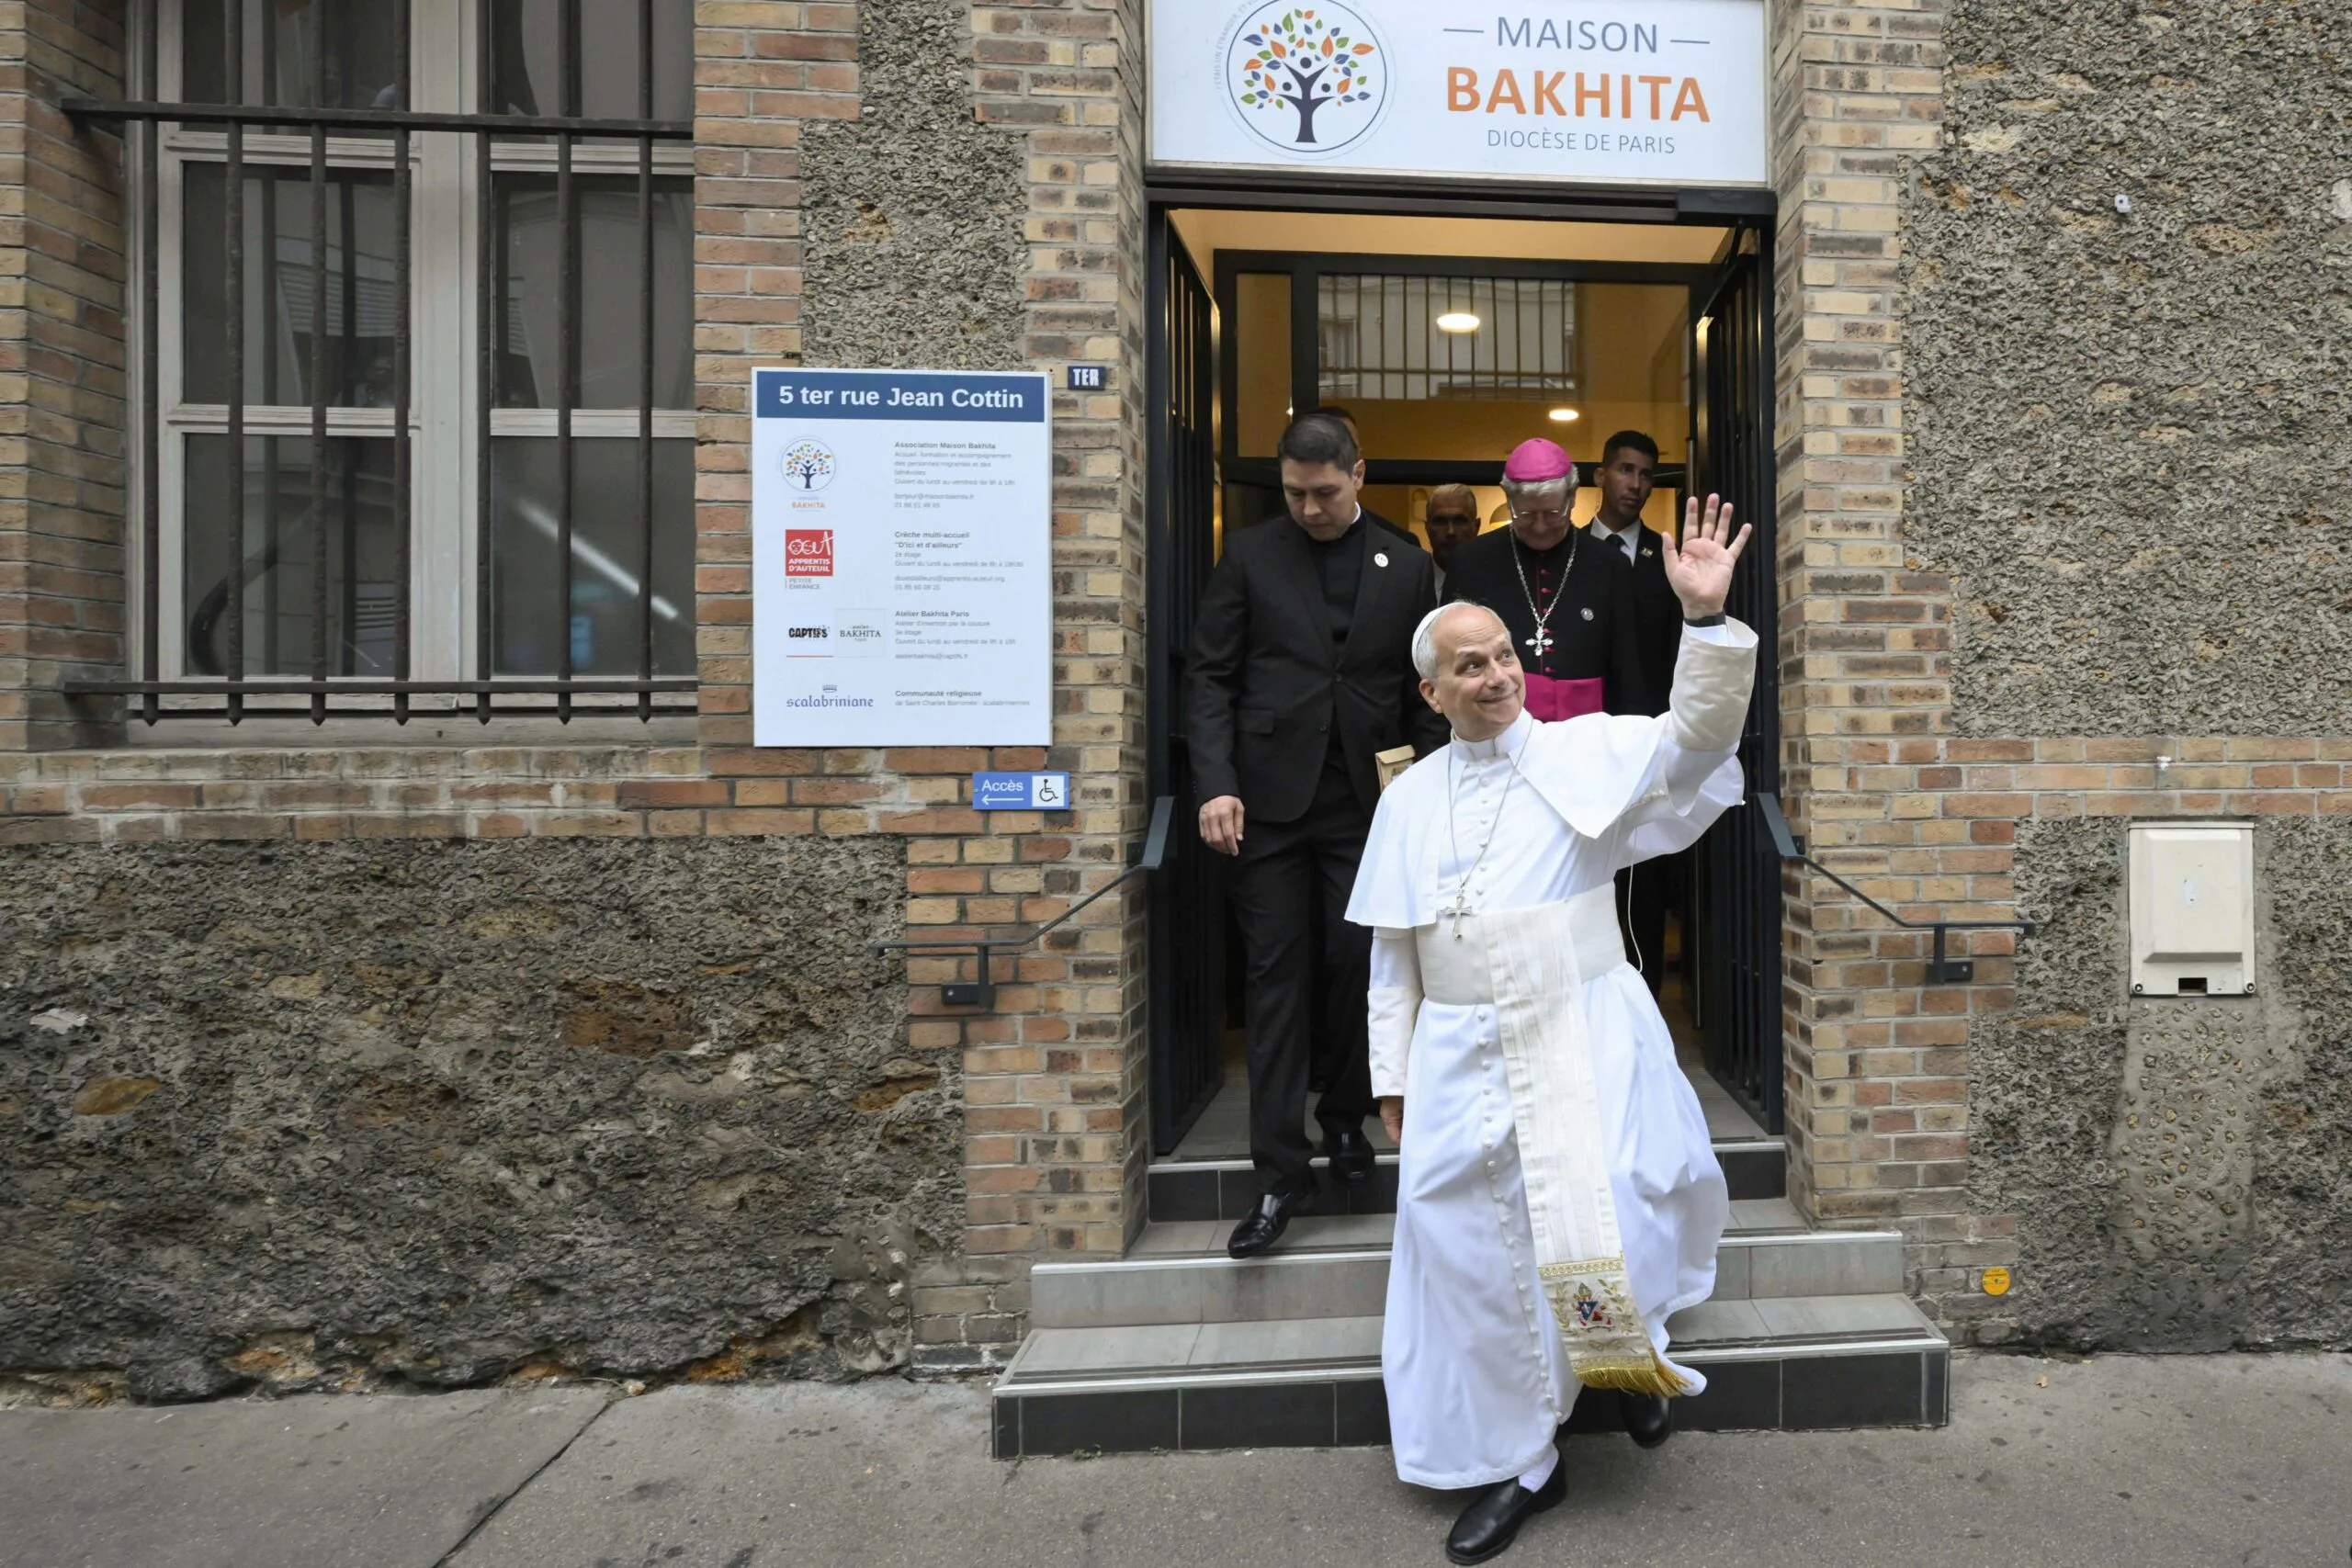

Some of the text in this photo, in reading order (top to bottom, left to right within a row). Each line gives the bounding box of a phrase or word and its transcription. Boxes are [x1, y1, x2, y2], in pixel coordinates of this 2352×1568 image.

[1498, 17, 1657, 53] MAISON
[1447, 66, 1711, 123] BAKHITA
[1487, 128, 1676, 154] DIOCÈSE DE PARIS
[1073, 368, 1099, 386] TER
[779, 386, 1023, 408] 5 ter rue Jean Cottin
[788, 627, 828, 637] CAPTIFS
[786, 694, 874, 707] scalabriniane
[981, 779, 1023, 792] Accès
